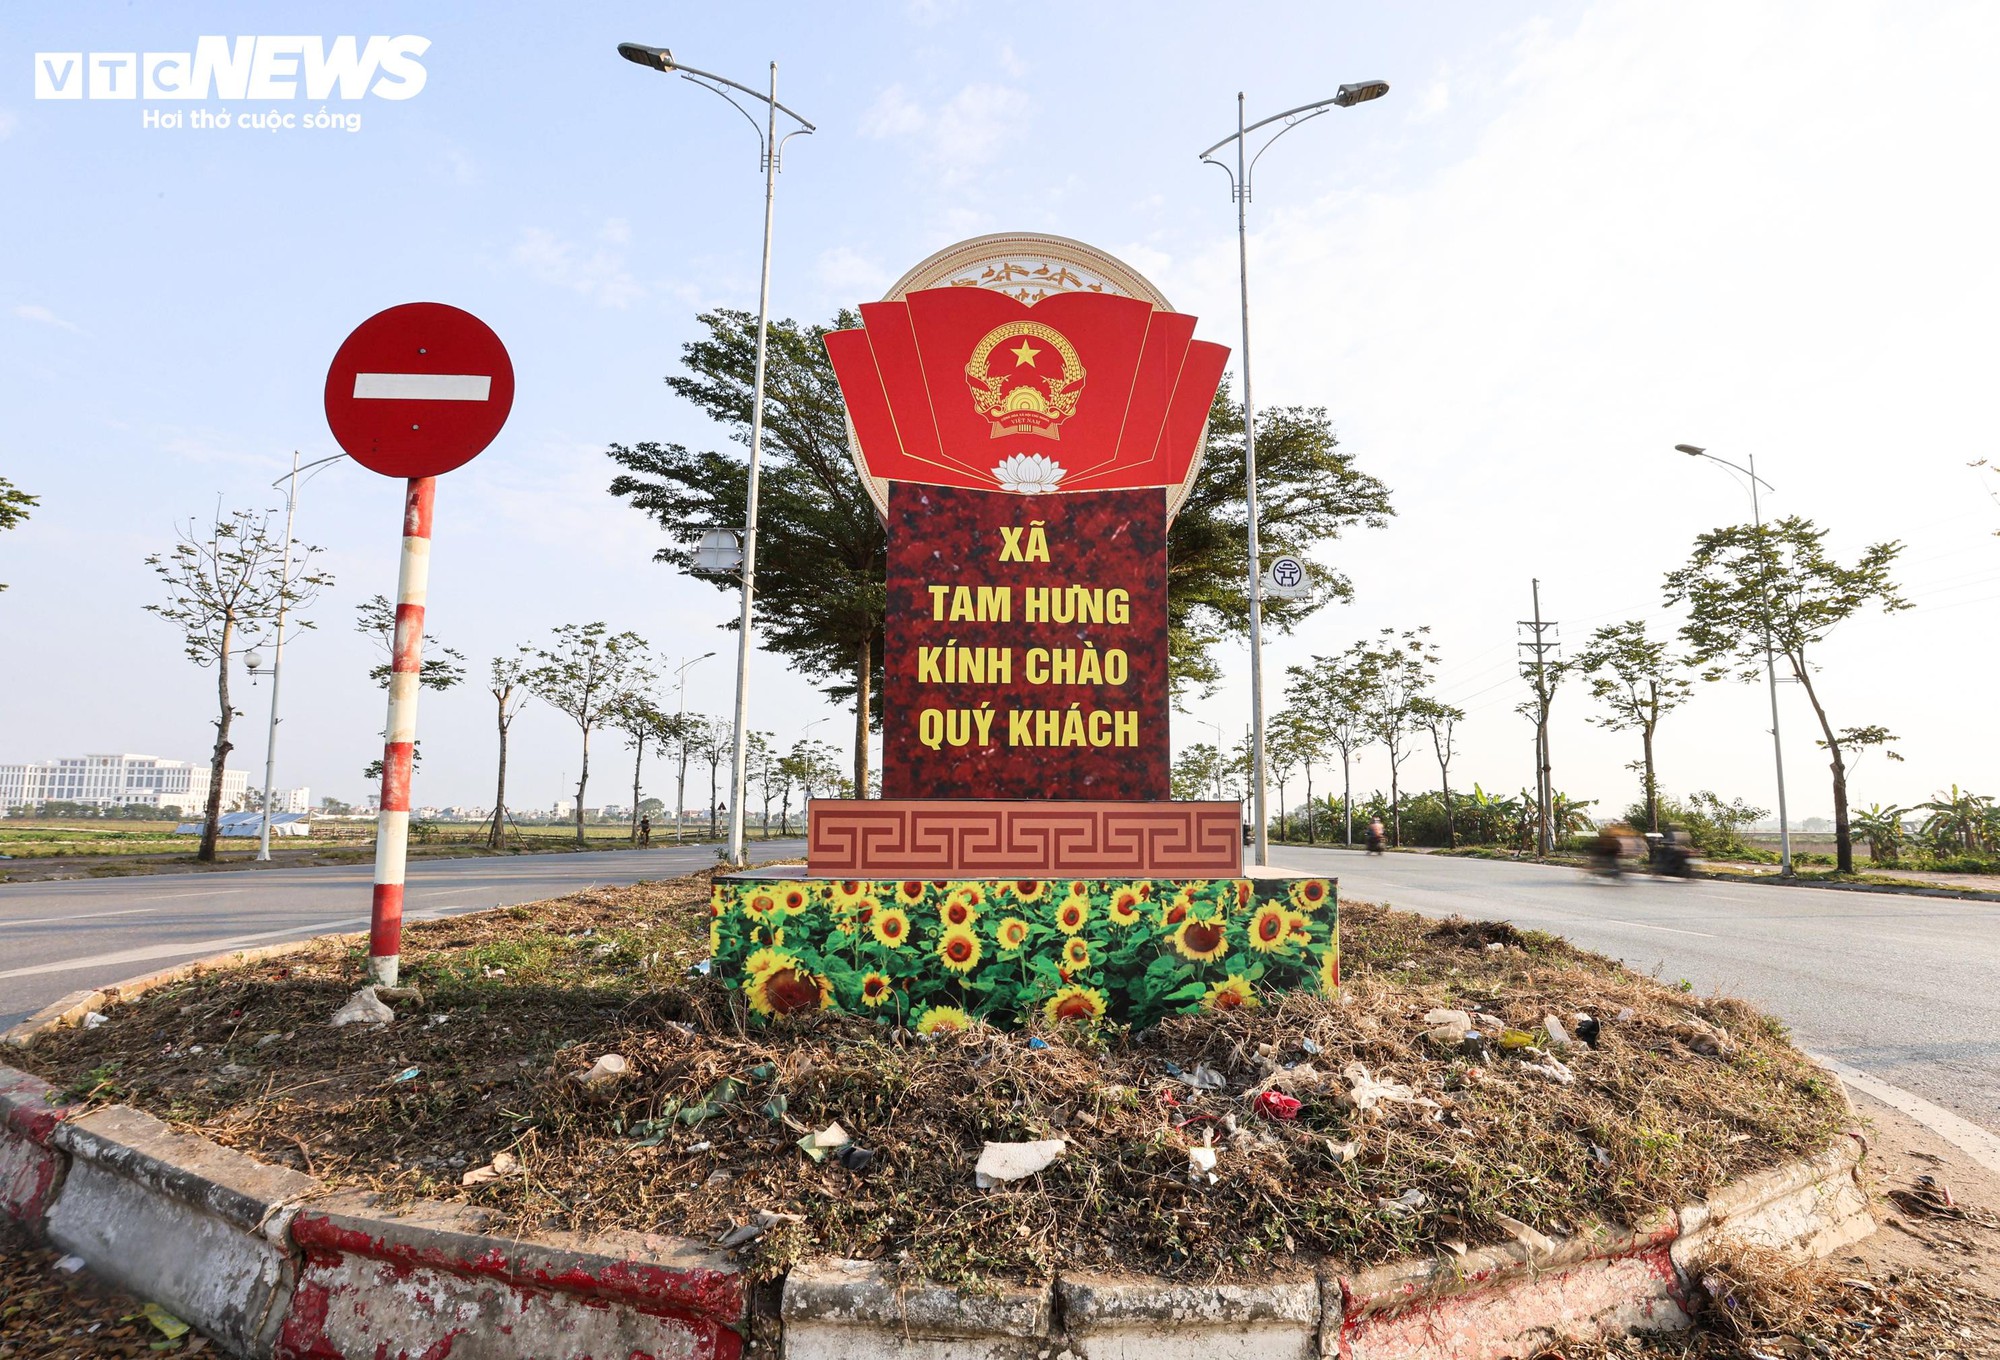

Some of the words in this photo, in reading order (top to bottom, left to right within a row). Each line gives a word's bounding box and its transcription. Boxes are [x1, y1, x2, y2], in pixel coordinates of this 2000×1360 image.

[998, 519, 1051, 563] XÃ
[928, 585, 1011, 623] TAM
[1025, 584, 1130, 625] HƯNG
[918, 639, 1012, 684] KÍNH
[1025, 640, 1128, 686] CHÀO
[918, 701, 996, 751] QUÝ
[1009, 702, 1139, 748] KHÁCH
